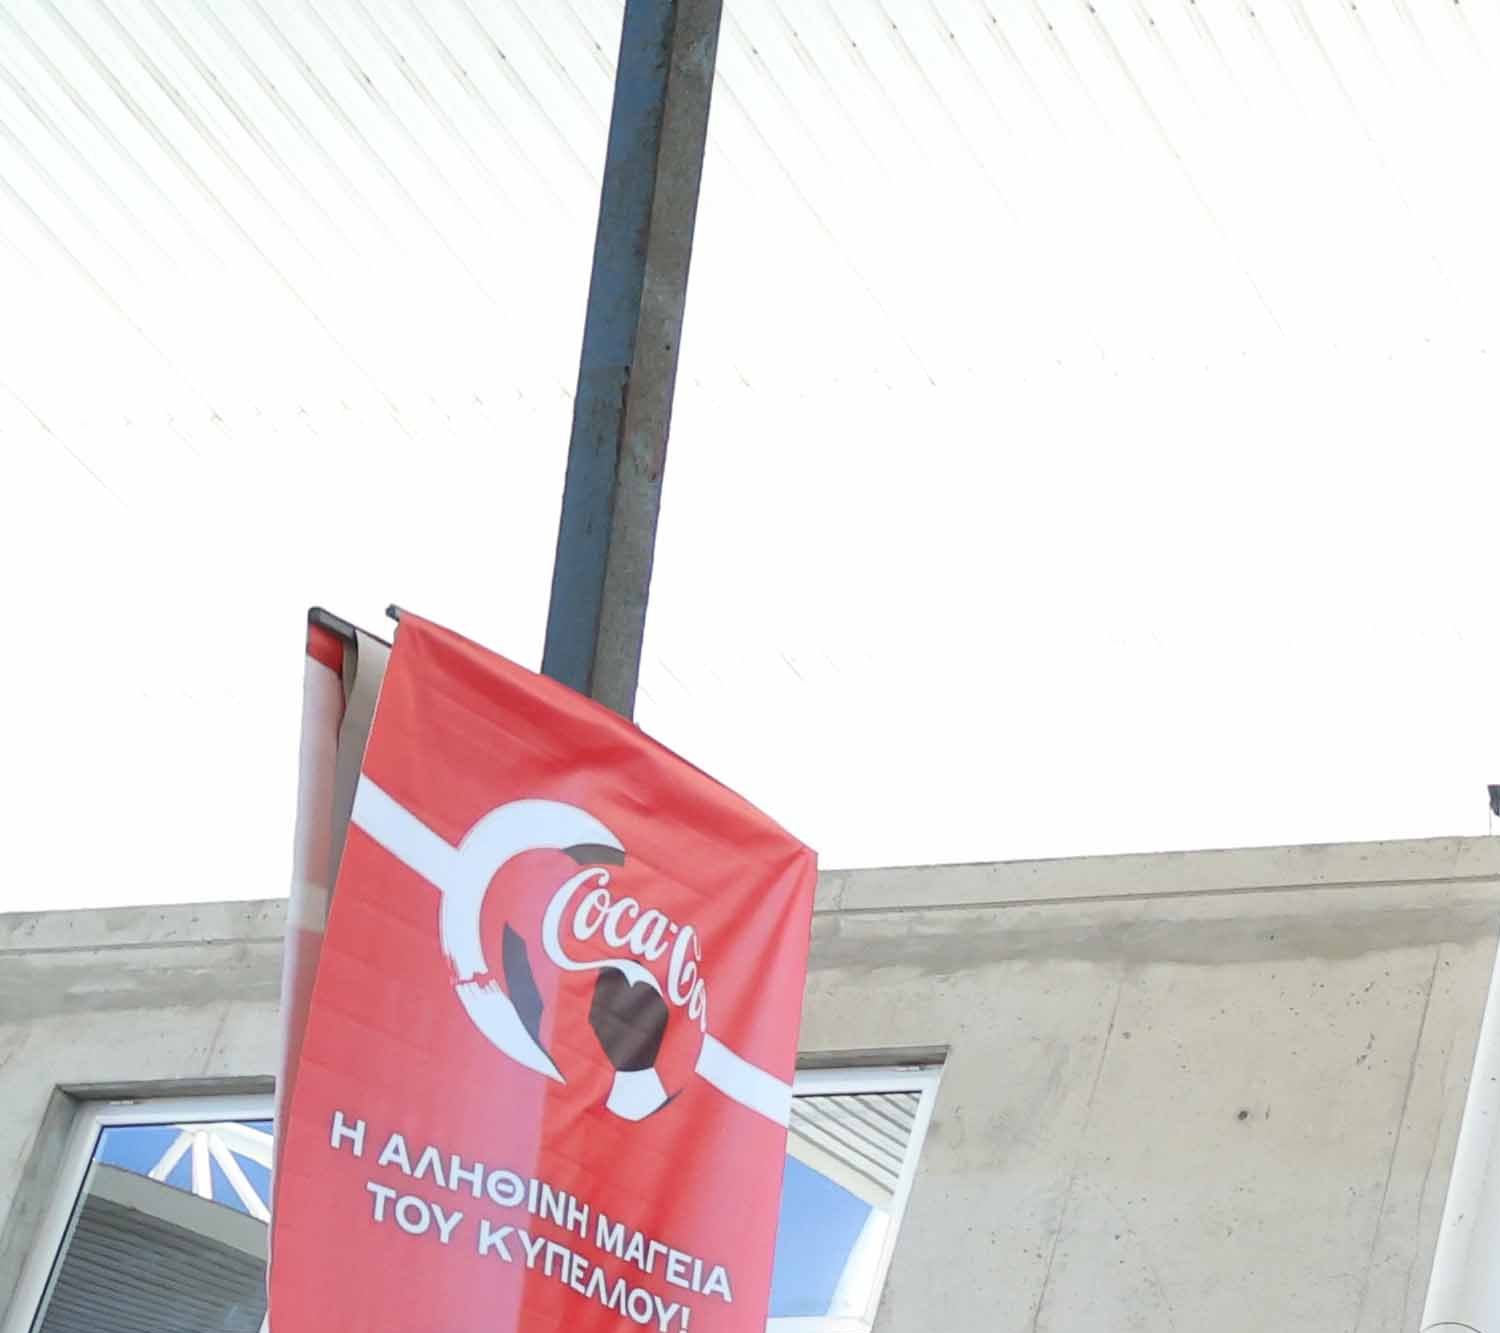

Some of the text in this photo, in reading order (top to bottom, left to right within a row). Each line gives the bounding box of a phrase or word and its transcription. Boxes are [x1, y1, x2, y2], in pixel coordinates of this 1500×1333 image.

[331, 1110, 733, 1303] Η ΑΛΗΘΙΝΗ ΜΑΓΕΙΑ
[366, 1181, 463, 1244] ΤΟΥ
